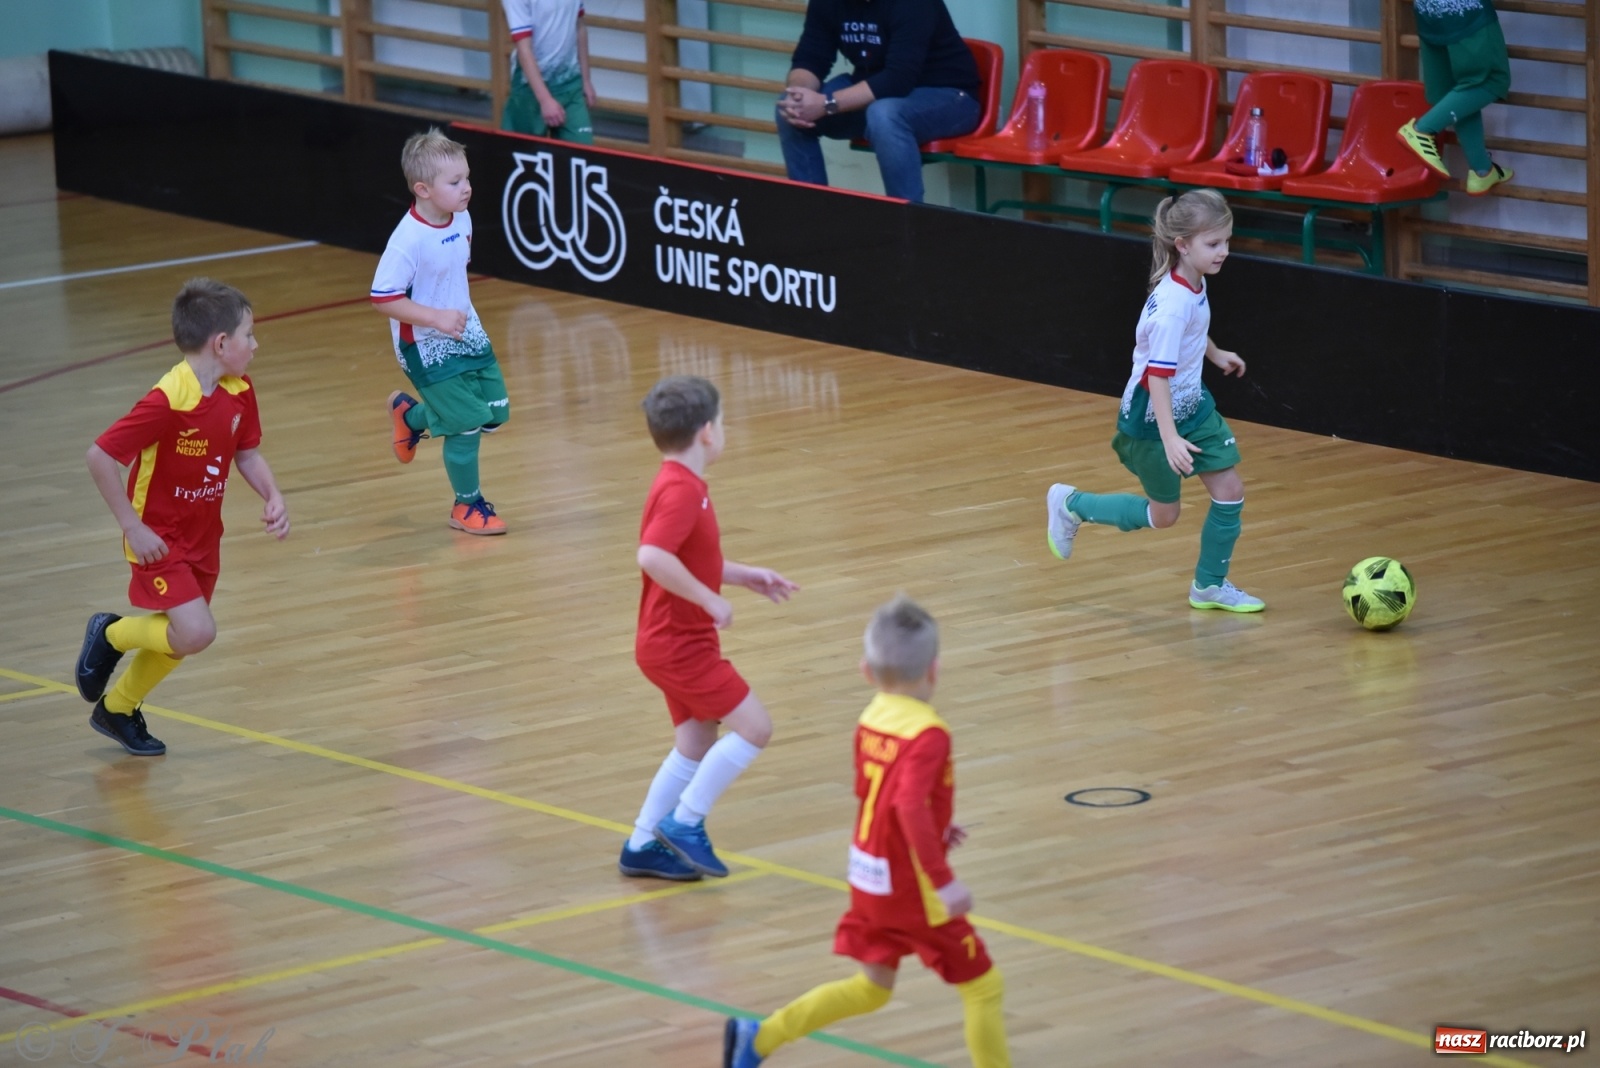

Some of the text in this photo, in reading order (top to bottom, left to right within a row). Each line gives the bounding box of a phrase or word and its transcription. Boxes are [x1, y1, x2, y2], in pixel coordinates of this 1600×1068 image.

[653, 186, 745, 247] ČESKÁ
[655, 244, 837, 313] UNIE SPORTU
[176, 438, 209, 448] GMINA
[153, 576, 168, 595] 9
[859, 760, 885, 843] 7
